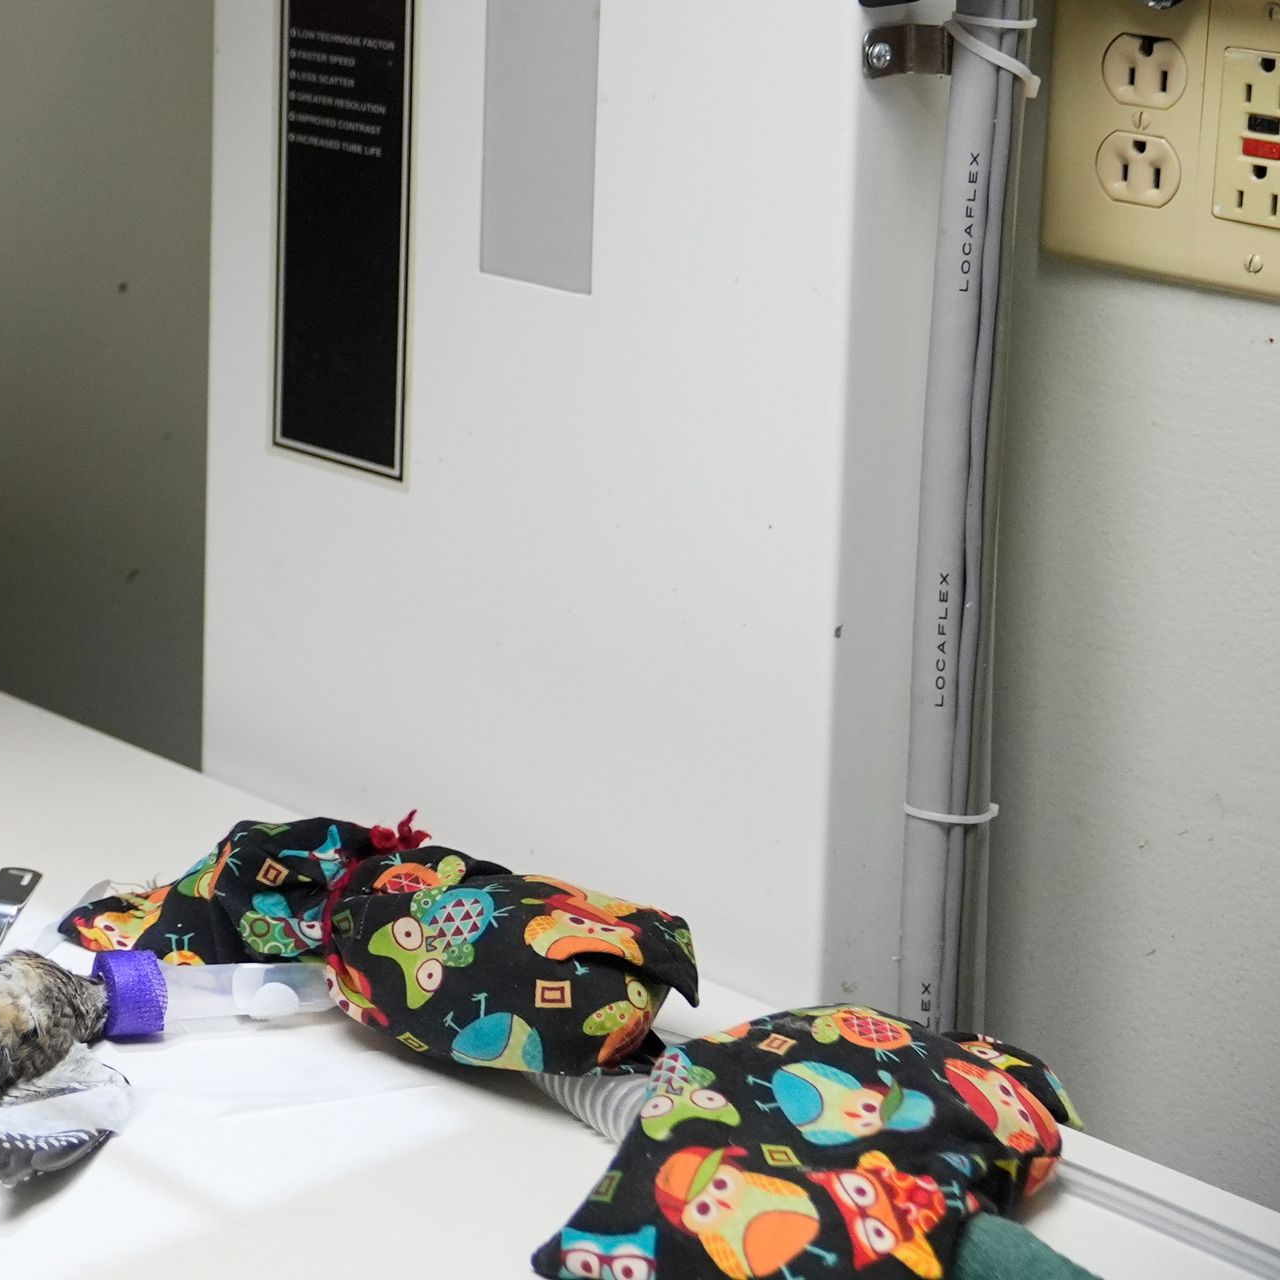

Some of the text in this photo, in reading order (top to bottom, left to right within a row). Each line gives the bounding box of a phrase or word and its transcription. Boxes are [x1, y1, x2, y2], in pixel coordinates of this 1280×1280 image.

[316, 31, 361, 47] TECHNIQUE
[362, 37, 395, 51] FACTOR
[318, 74, 355, 88] SCATTER
[296, 91, 386, 115] GREATER RESOLUTION
[296, 113, 381, 135] IMPROVED CONTRAST
[296, 134, 341, 150] INCREASED
[341, 141, 363, 155] TUBE
[959, 152, 980, 292] LOCAFLEX
[934, 572, 950, 707] LOCAFLEX
